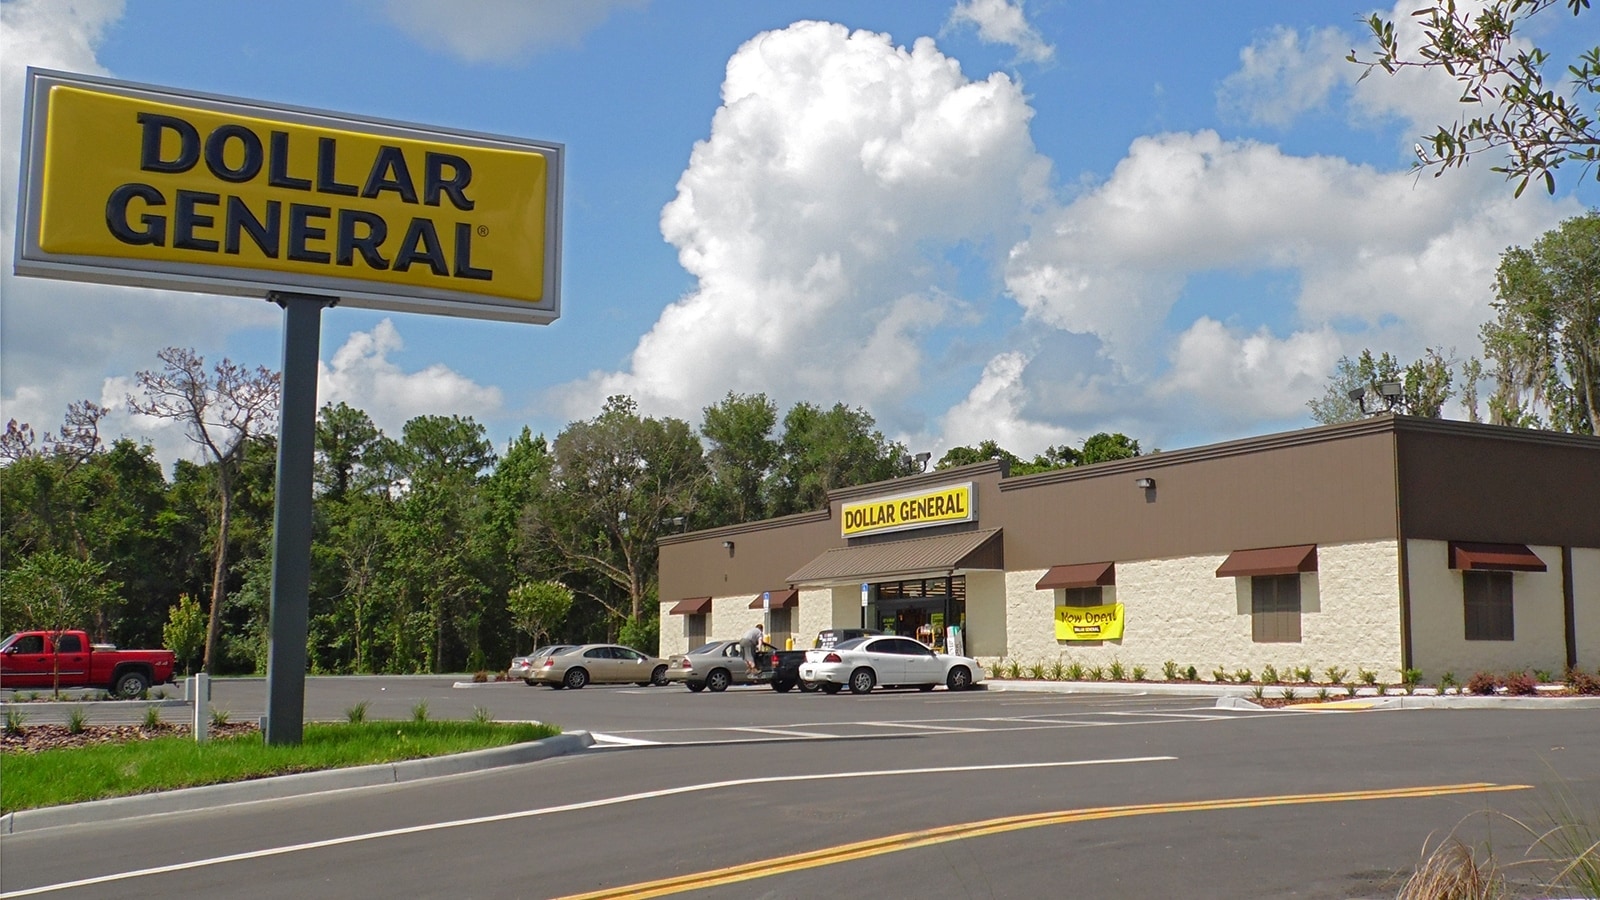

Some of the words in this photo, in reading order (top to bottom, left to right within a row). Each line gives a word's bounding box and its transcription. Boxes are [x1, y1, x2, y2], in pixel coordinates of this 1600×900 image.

[137, 112, 475, 211] DOLLAR
[845, 504, 896, 529] DOLLAR
[1061, 611, 1082, 623] Now
